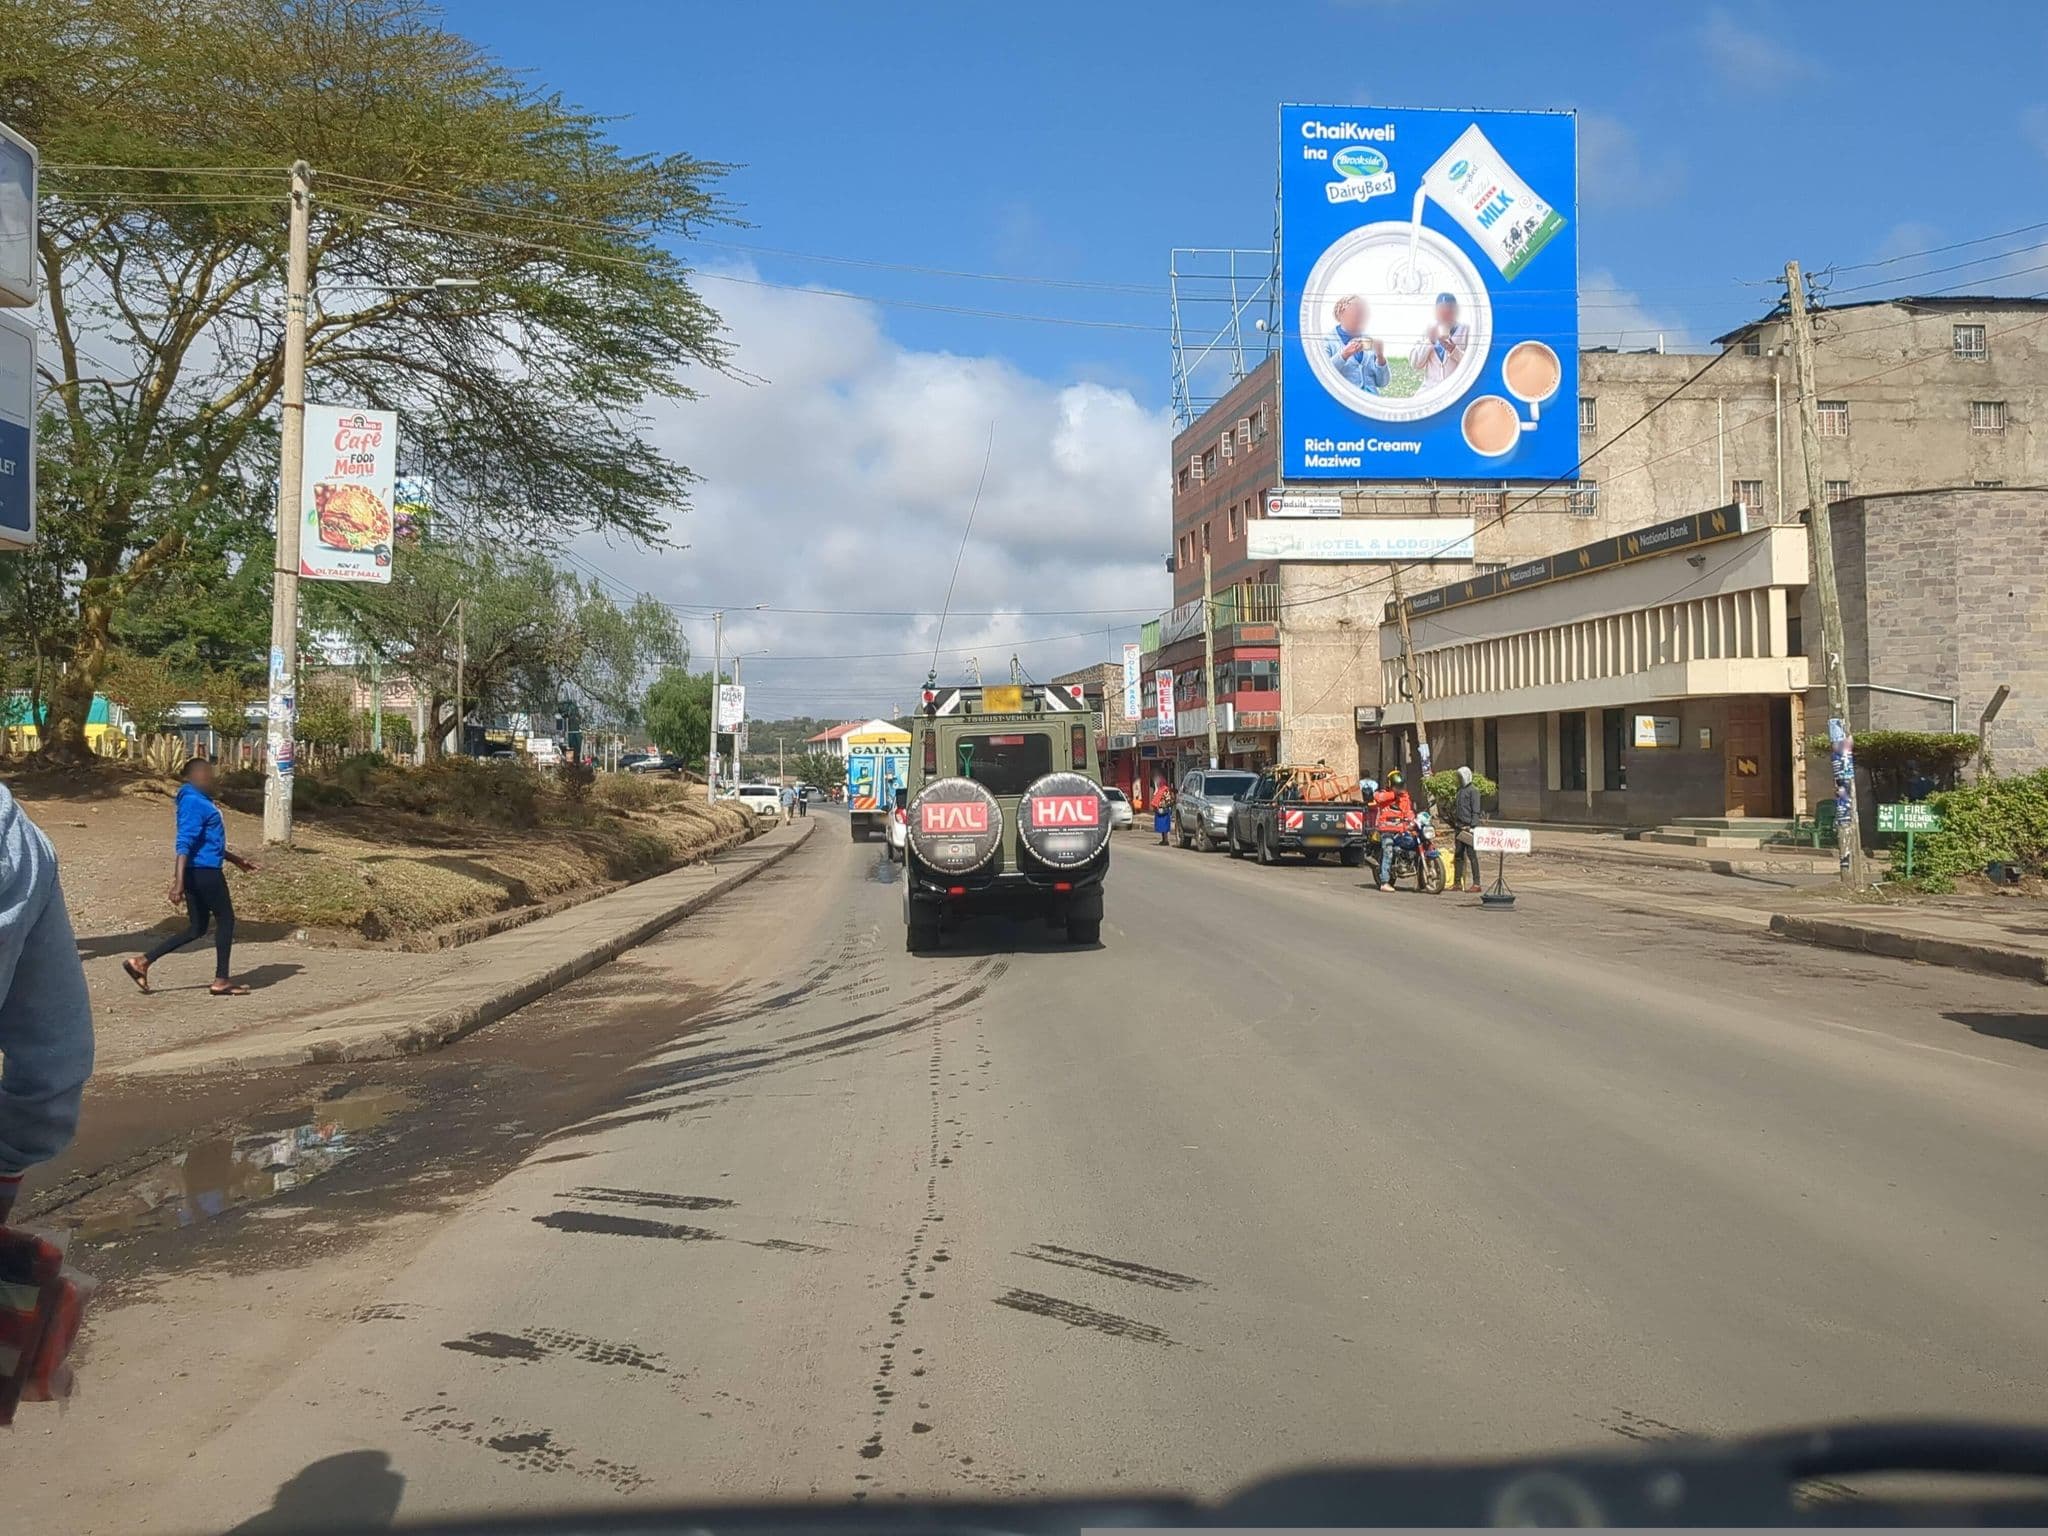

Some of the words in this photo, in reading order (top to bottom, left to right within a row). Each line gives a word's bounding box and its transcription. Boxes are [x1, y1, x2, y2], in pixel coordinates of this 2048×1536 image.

[1301, 121, 1395, 141] ChaiKweli
[1303, 145, 1328, 160] ina
[1338, 154, 1382, 166] Brookside
[1328, 177, 1393, 200] DairyBest
[1476, 190, 1515, 230] MILK
[334, 429, 382, 454] Café
[1304, 438, 1335, 452] Rich
[1337, 438, 1365, 452] and
[1367, 438, 1422, 454] Creamy
[350, 453, 375, 463] FOOD
[1304, 454, 1361, 467] Maziwa
[334, 459, 375, 476] Menu
[1310, 538, 1363, 549] HOTEL
[1369, 538, 1382, 549] &
[1387, 538, 1470, 549] LODGINS
[1639, 528, 1669, 548] National
[1669, 522, 1689, 541] Bank
[1509, 567, 1531, 581] National
[1531, 564, 1546, 578] Bank
[927, 806, 982, 829] HAL
[1038, 800, 1093, 822] HAL
[1898, 814, 1939, 822] ASSEMBLY
[1904, 805, 1927, 814] FIRE
